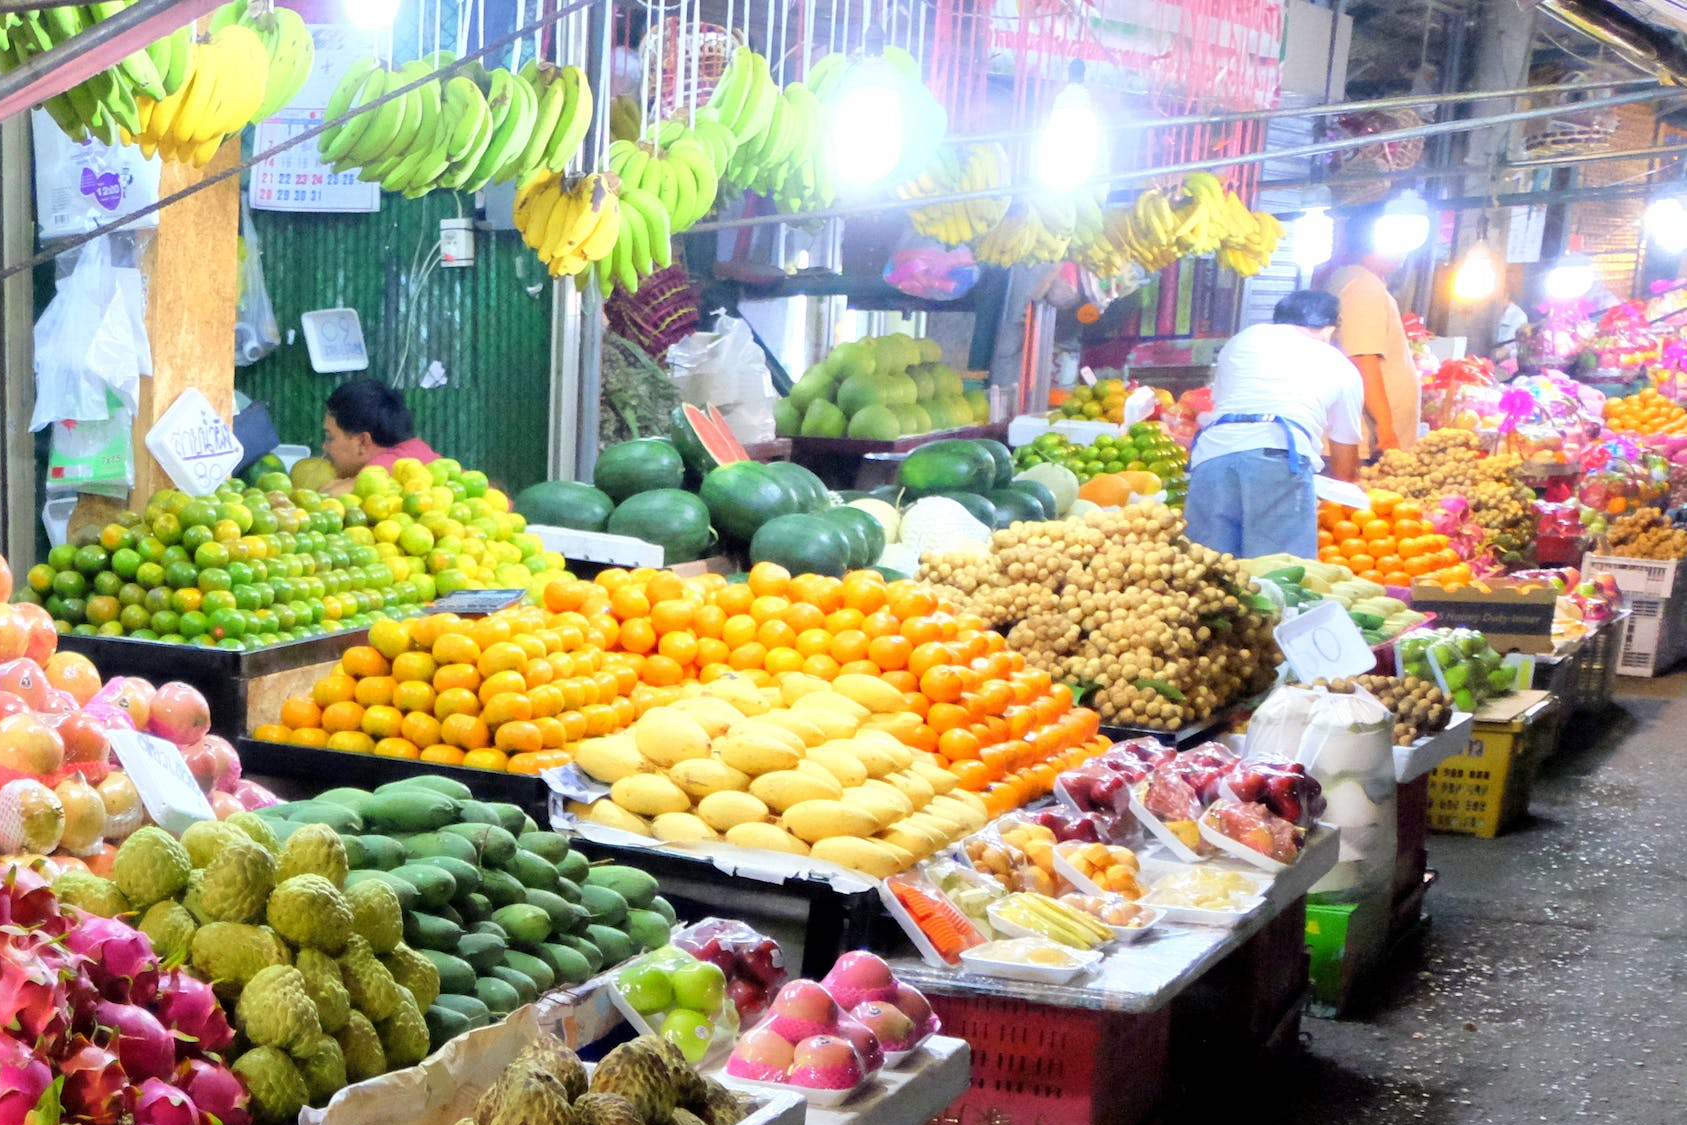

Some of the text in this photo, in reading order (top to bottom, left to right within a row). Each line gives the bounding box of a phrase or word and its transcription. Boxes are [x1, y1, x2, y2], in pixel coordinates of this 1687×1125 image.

[261, 172, 274, 184] 21
[279, 173, 292, 185] 22
[296, 173, 309, 185] 23
[294, 189, 307, 201] 30
